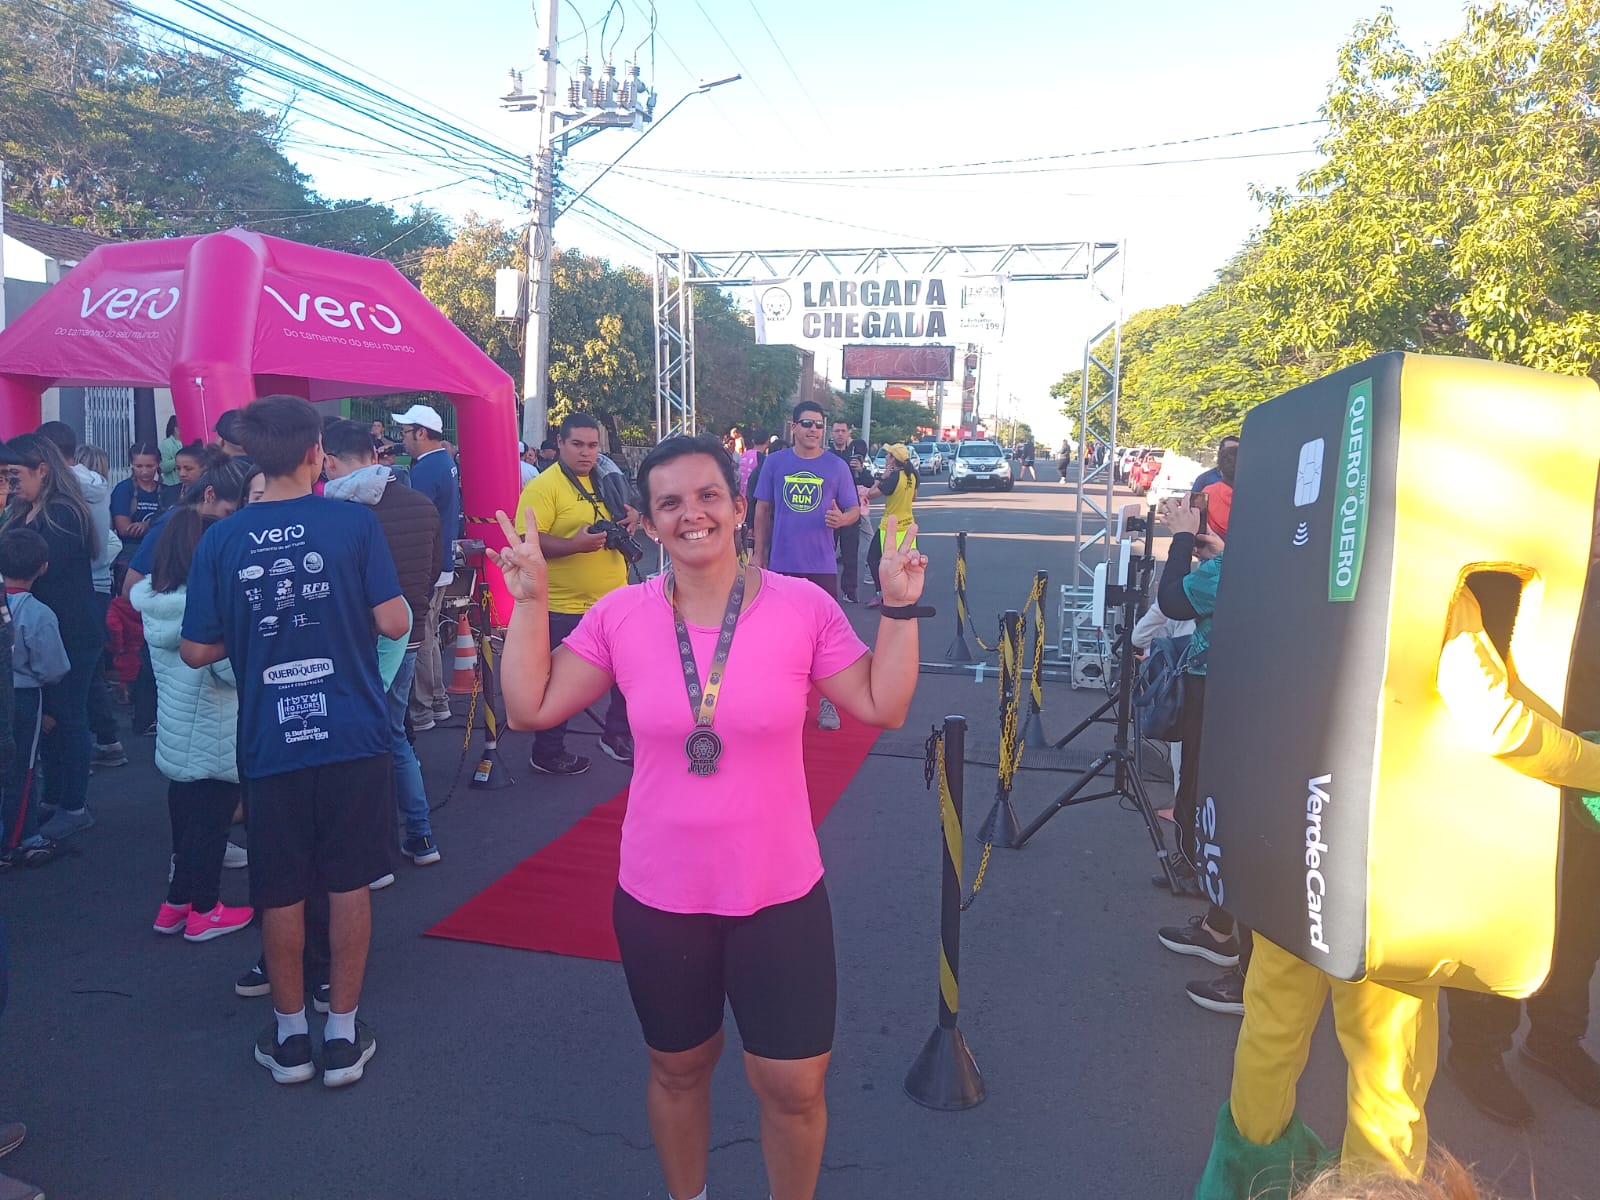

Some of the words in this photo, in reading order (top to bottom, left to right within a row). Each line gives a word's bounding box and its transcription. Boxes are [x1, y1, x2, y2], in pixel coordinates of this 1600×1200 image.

[80, 286, 180, 320] vero
[803, 278, 947, 308] LARGADA
[263, 285, 402, 335] vero
[54, 327, 67, 336] Do
[67, 328, 104, 338] tamanho
[104, 330, 116, 338] do
[116, 331, 130, 339] seu
[802, 310, 947, 339] CHEGADA
[283, 327, 299, 337] Do
[299, 330, 348, 345] tamanho
[348, 337, 361, 347] do
[362, 340, 381, 350] seu
[382, 342, 415, 353] mundo
[791, 493, 812, 505] RUN
[248, 524, 305, 544] vero
[302, 582, 330, 593] RFB
[297, 702, 320, 710] FLORES
[285, 734, 314, 743] Constant
[291, 727, 321, 736] Benjamin
[1305, 773, 1332, 954] VerdeCard
